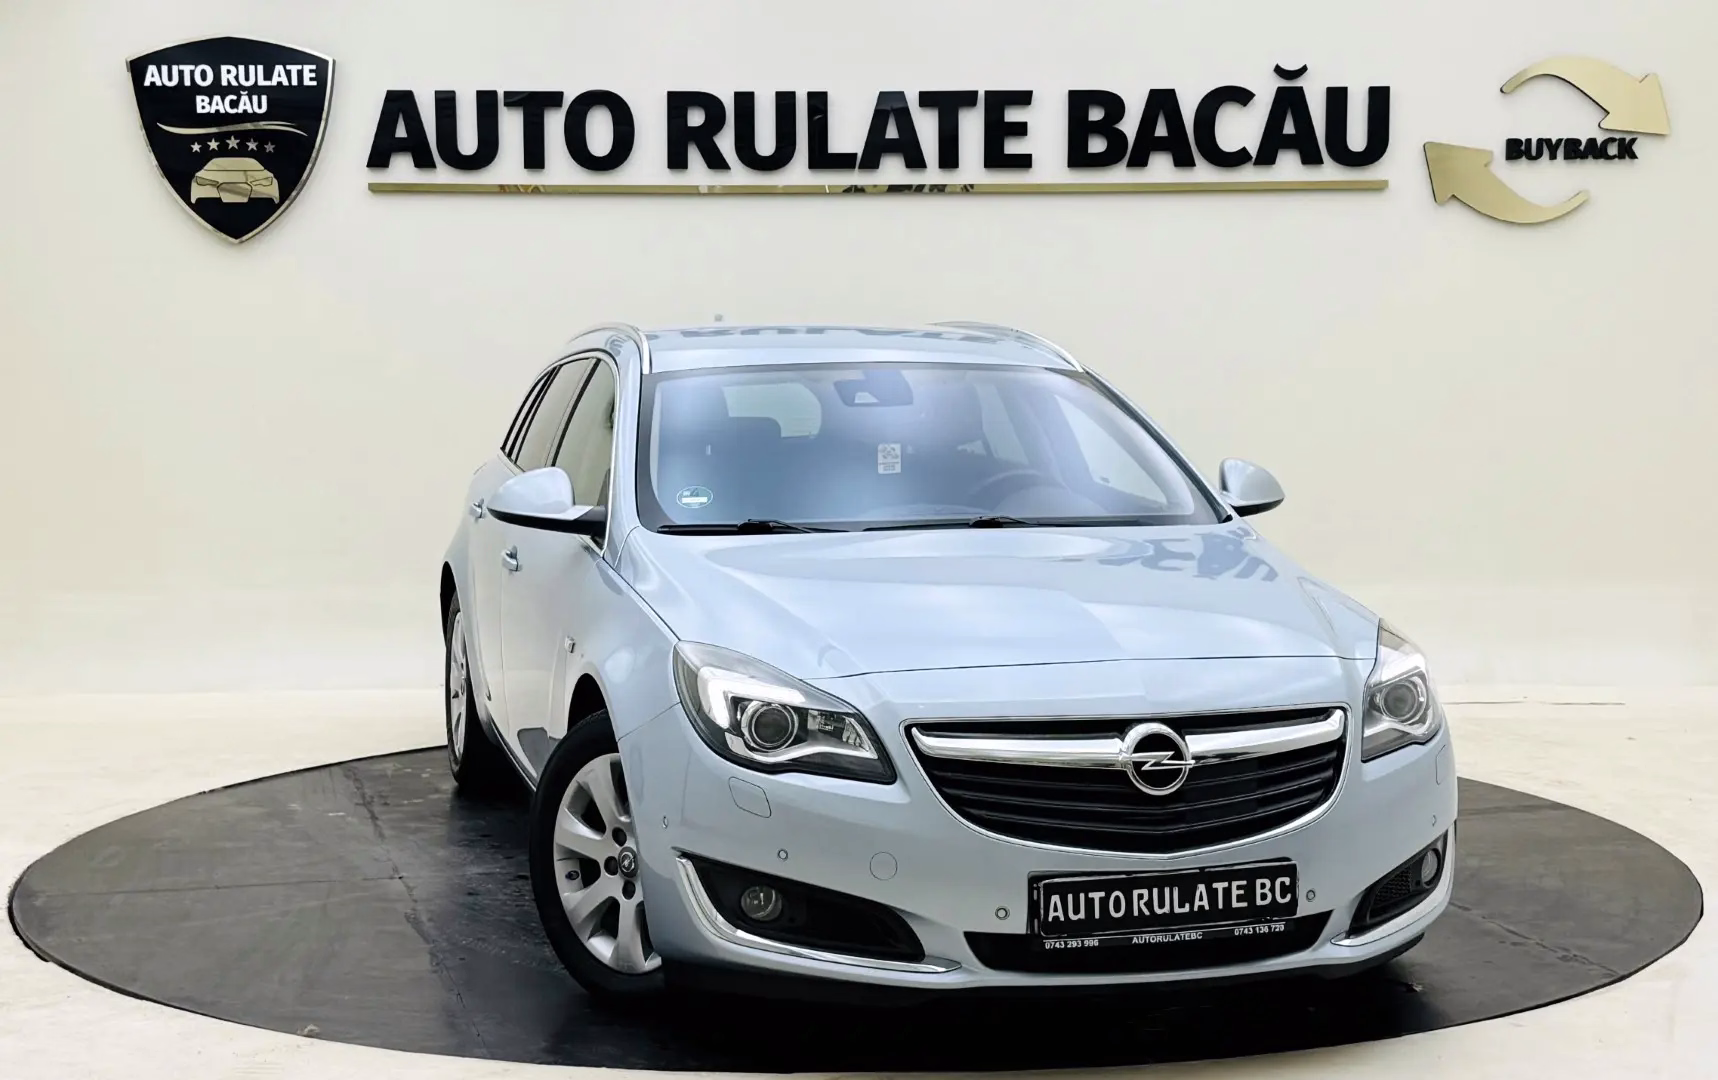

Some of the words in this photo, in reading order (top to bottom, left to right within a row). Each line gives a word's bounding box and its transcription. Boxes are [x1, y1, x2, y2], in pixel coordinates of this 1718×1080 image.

[144, 64, 214, 87] AUTO
[220, 65, 318, 87] RULATE
[195, 91, 268, 114] BACĂU
[366, 89, 635, 171] AUTO
[667, 90, 1033, 171] RULATE
[1067, 63, 1390, 169] BACĂU
[1505, 137, 1639, 161] BUYBACK
[1048, 890, 1126, 922] AUTO
[1132, 880, 1248, 915] RULATE
[1255, 876, 1292, 906] BC
[1132, 931, 1203, 944] AUTORULATEBC
